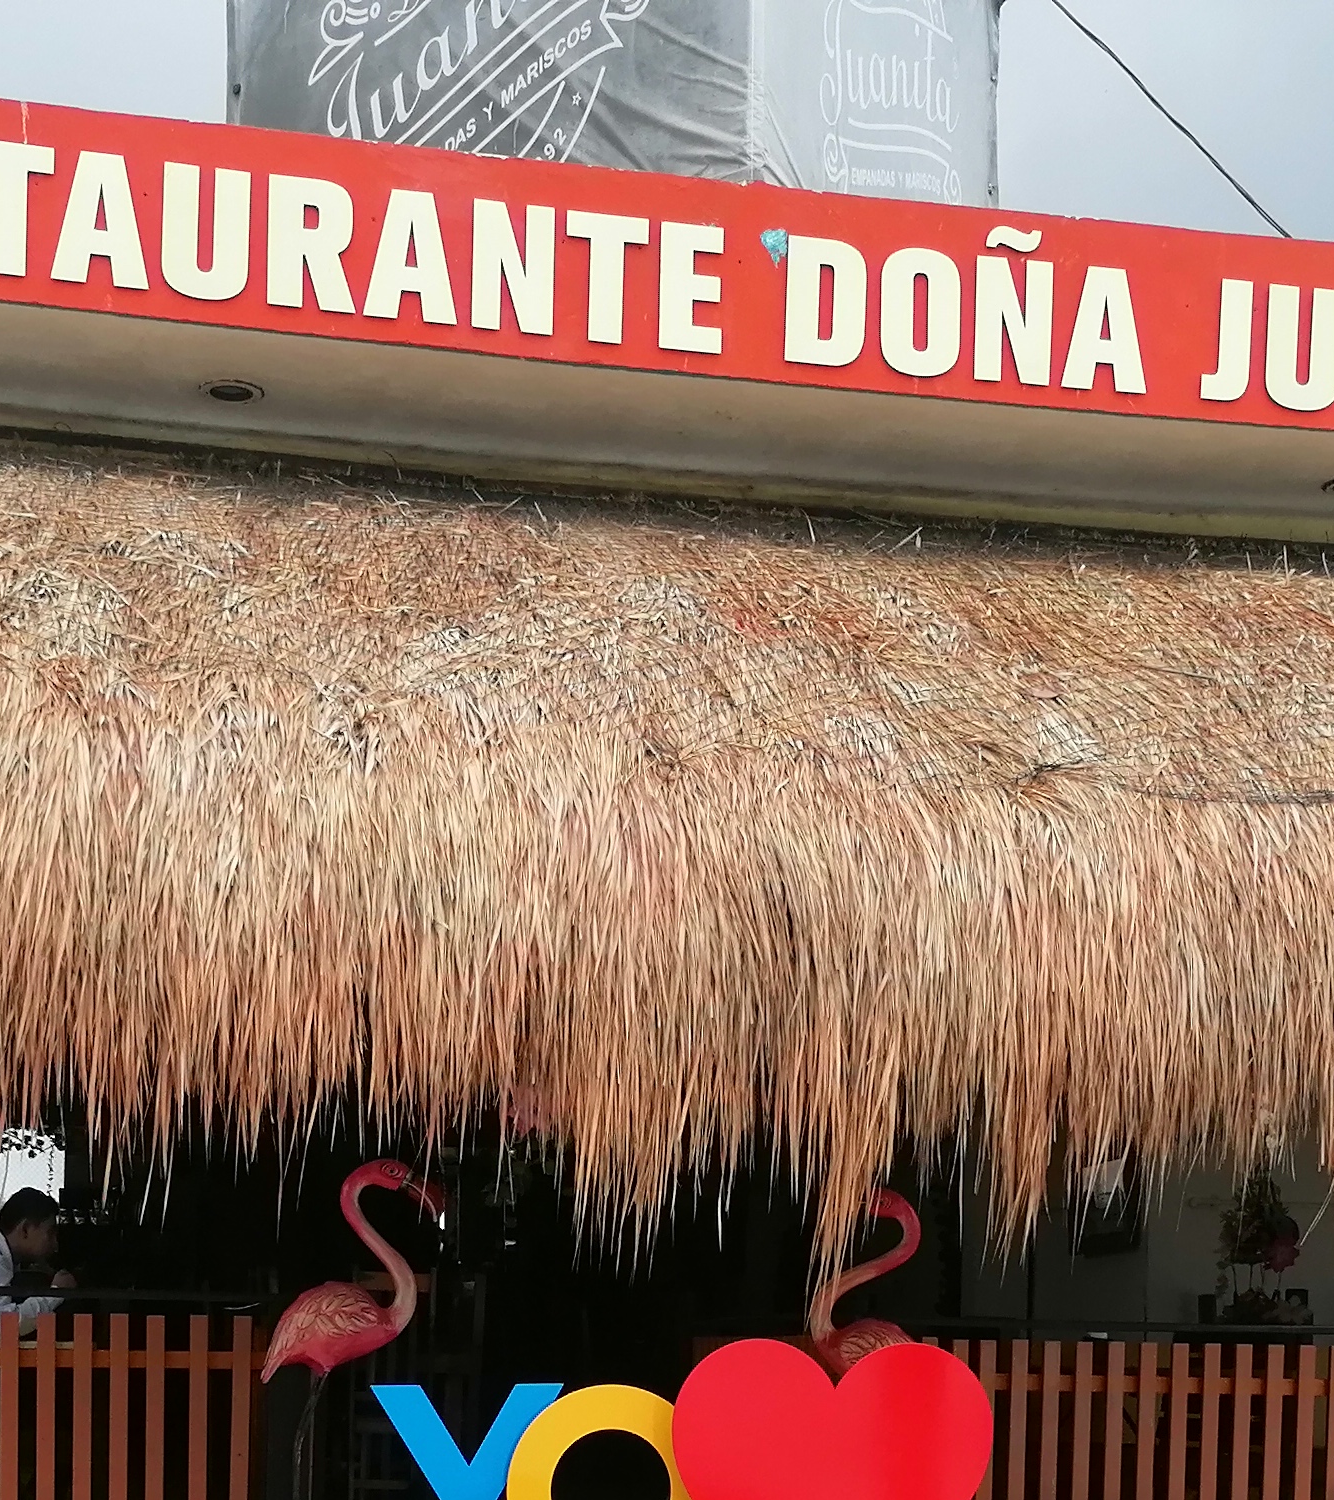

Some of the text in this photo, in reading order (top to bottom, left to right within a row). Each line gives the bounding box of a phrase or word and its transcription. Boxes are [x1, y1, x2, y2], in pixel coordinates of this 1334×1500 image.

[482, 101, 494, 121] Y
[500, 19, 592, 109] MARISCOS
[819, 0, 960, 134] Juanita
[851, 166, 895, 188] EMPANADAS
[905, 171, 942, 196] MARISCOS
[784, 225, 1148, 395] DOÑA
